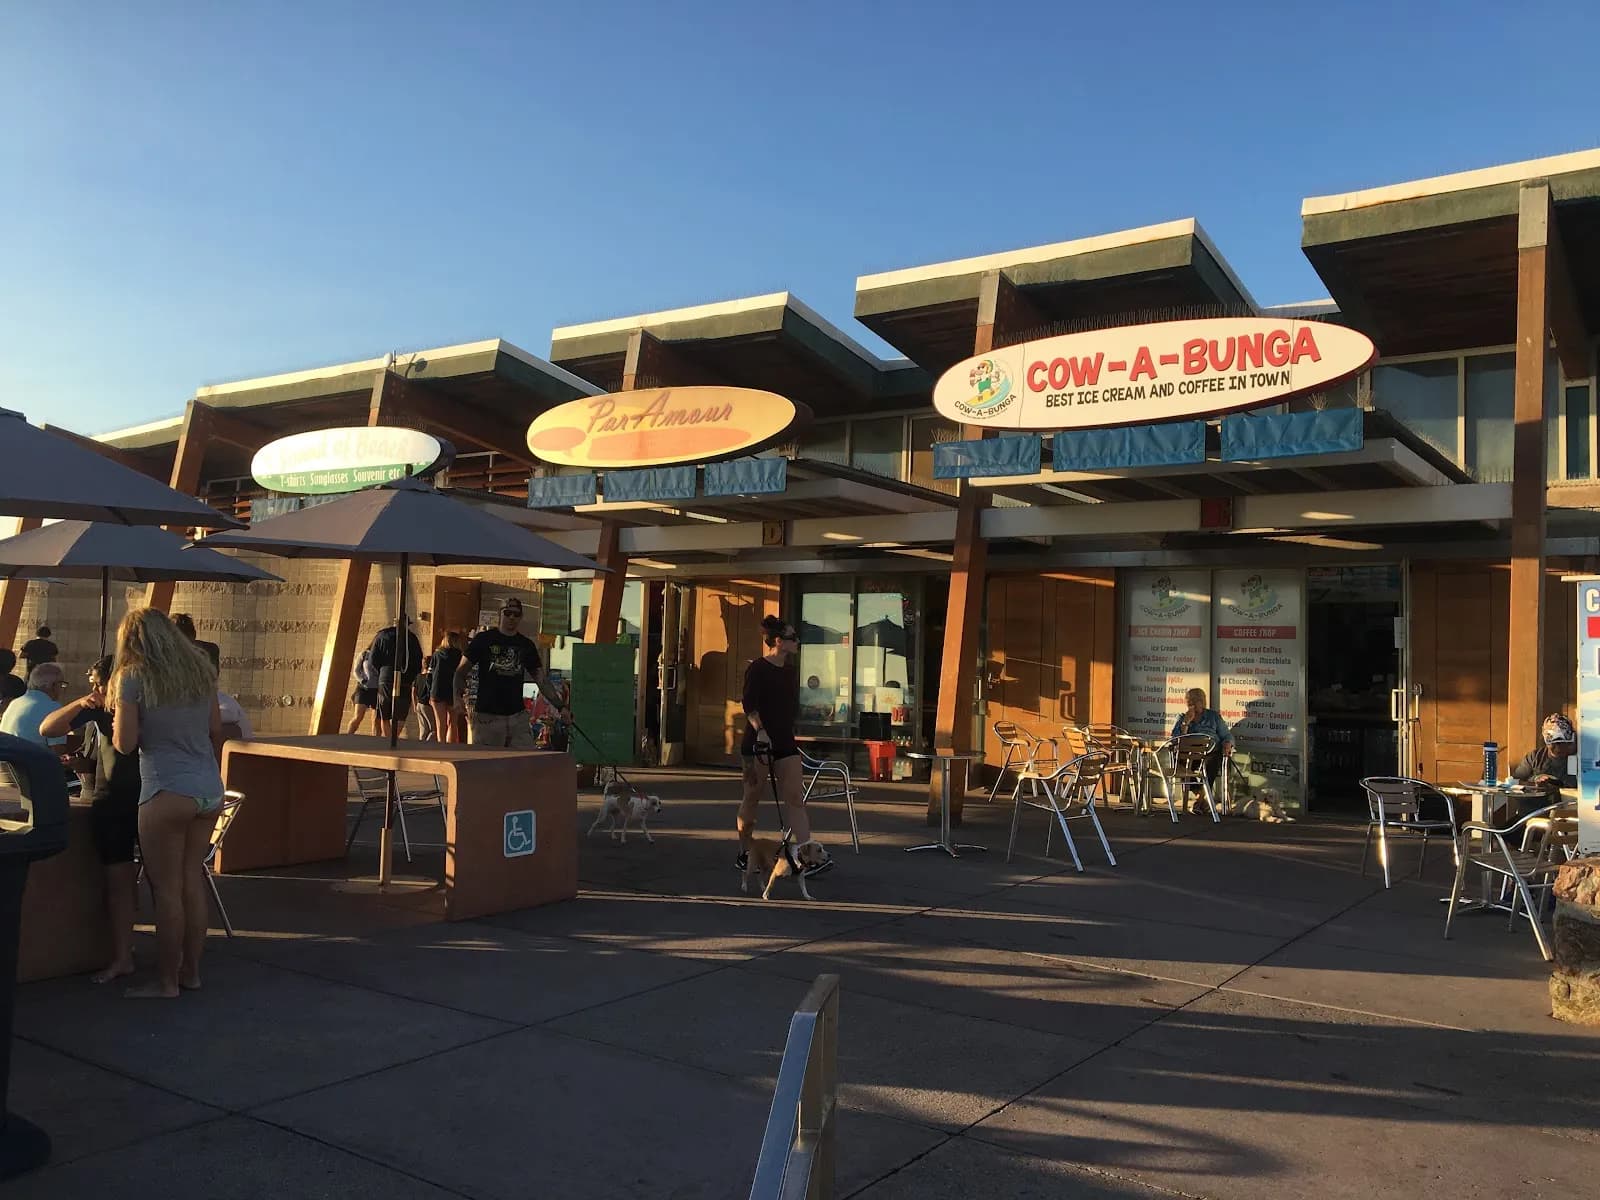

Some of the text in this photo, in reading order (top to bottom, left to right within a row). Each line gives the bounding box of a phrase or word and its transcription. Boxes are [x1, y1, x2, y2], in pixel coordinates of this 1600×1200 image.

[1027, 327, 1321, 392] COW-A-BUNGA
[1046, 370, 1290, 408] BEST ICE CREAM AND COFFEE IN TOWN
[954, 393, 1016, 417] COW-A-BUNGA
[280, 475, 306, 488] T-shirts
[310, 472, 349, 487] Sunglasses
[353, 468, 386, 483] Souvenir
[1233, 629, 1257, 637] COFFEE
